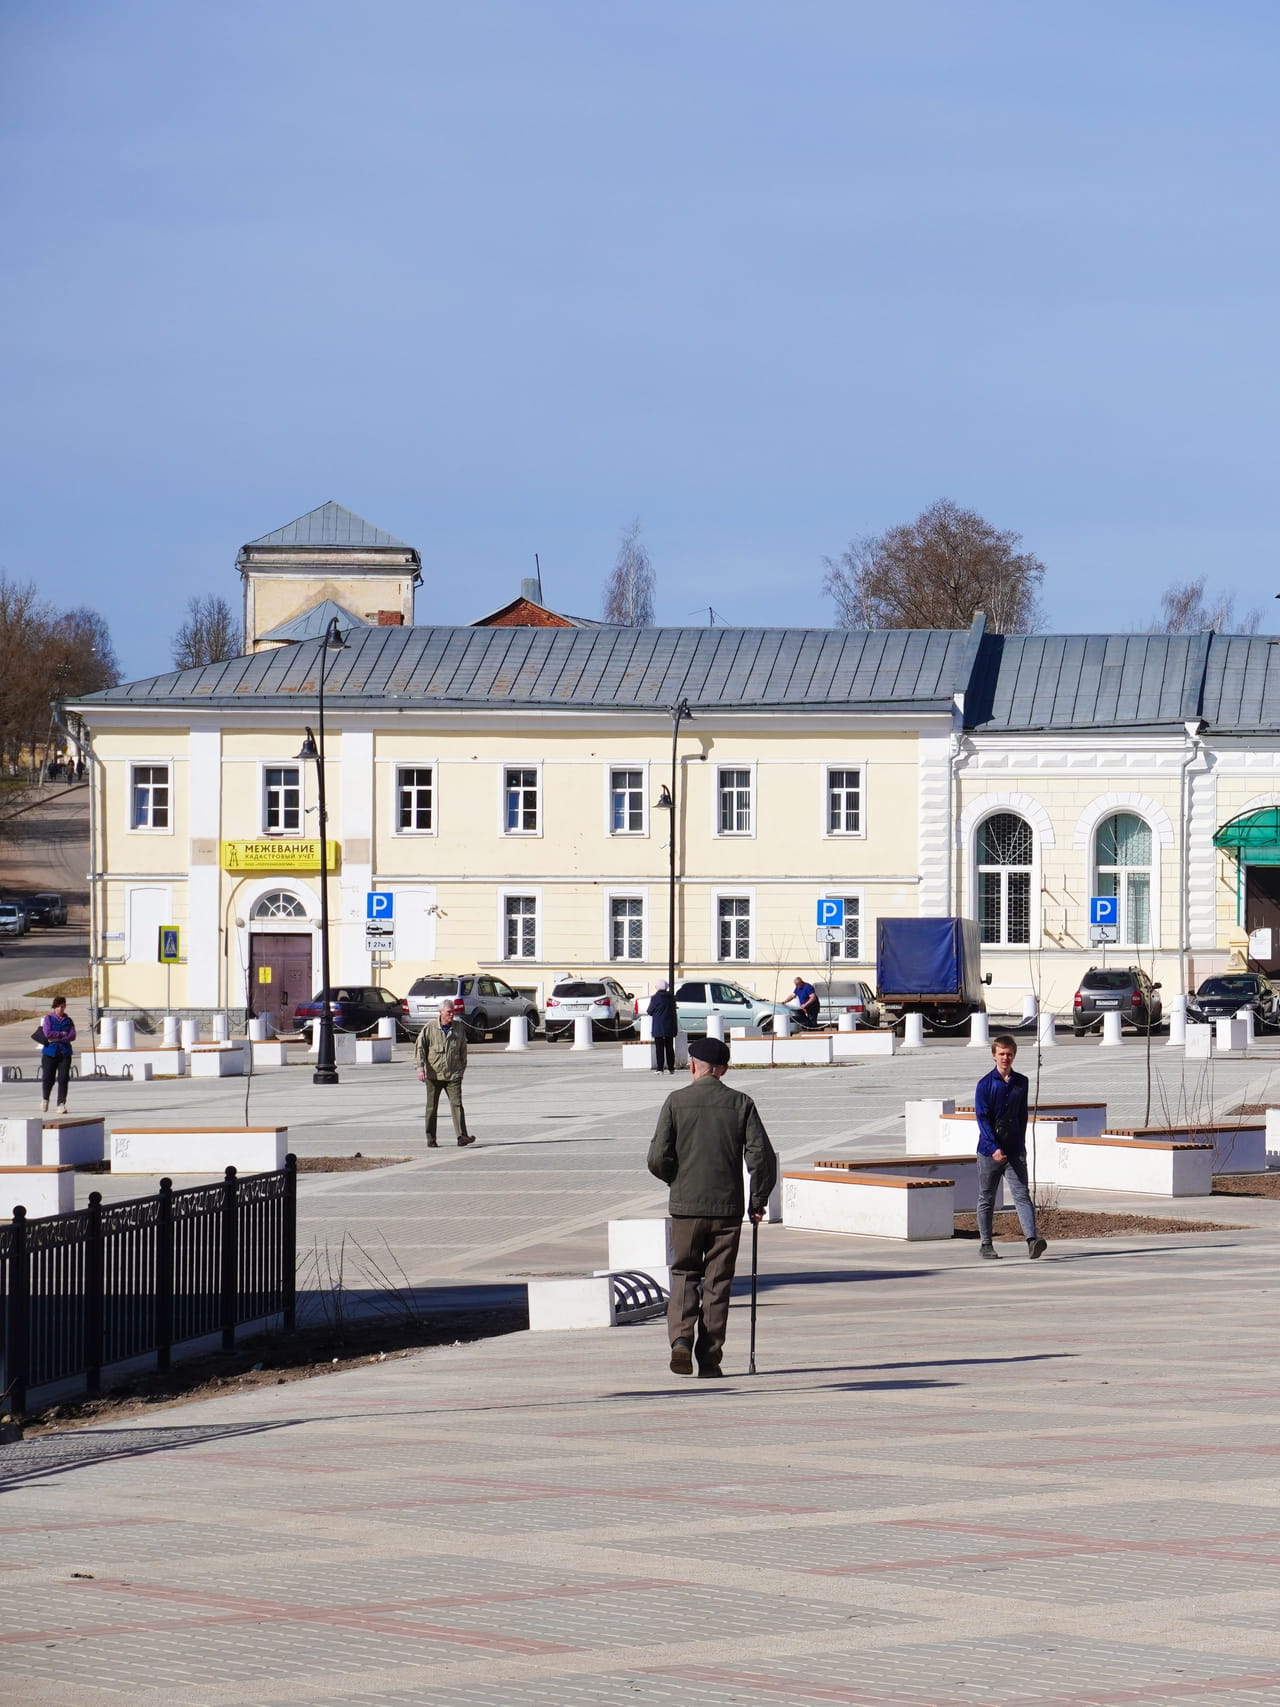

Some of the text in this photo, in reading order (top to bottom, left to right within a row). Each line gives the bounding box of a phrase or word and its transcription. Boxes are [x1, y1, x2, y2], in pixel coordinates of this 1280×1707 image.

[244, 844, 315, 853] МЕЖЕВАНИЕ
[372, 895, 388, 917] P
[822, 902, 838, 924] P
[1096, 900, 1112, 922] P
